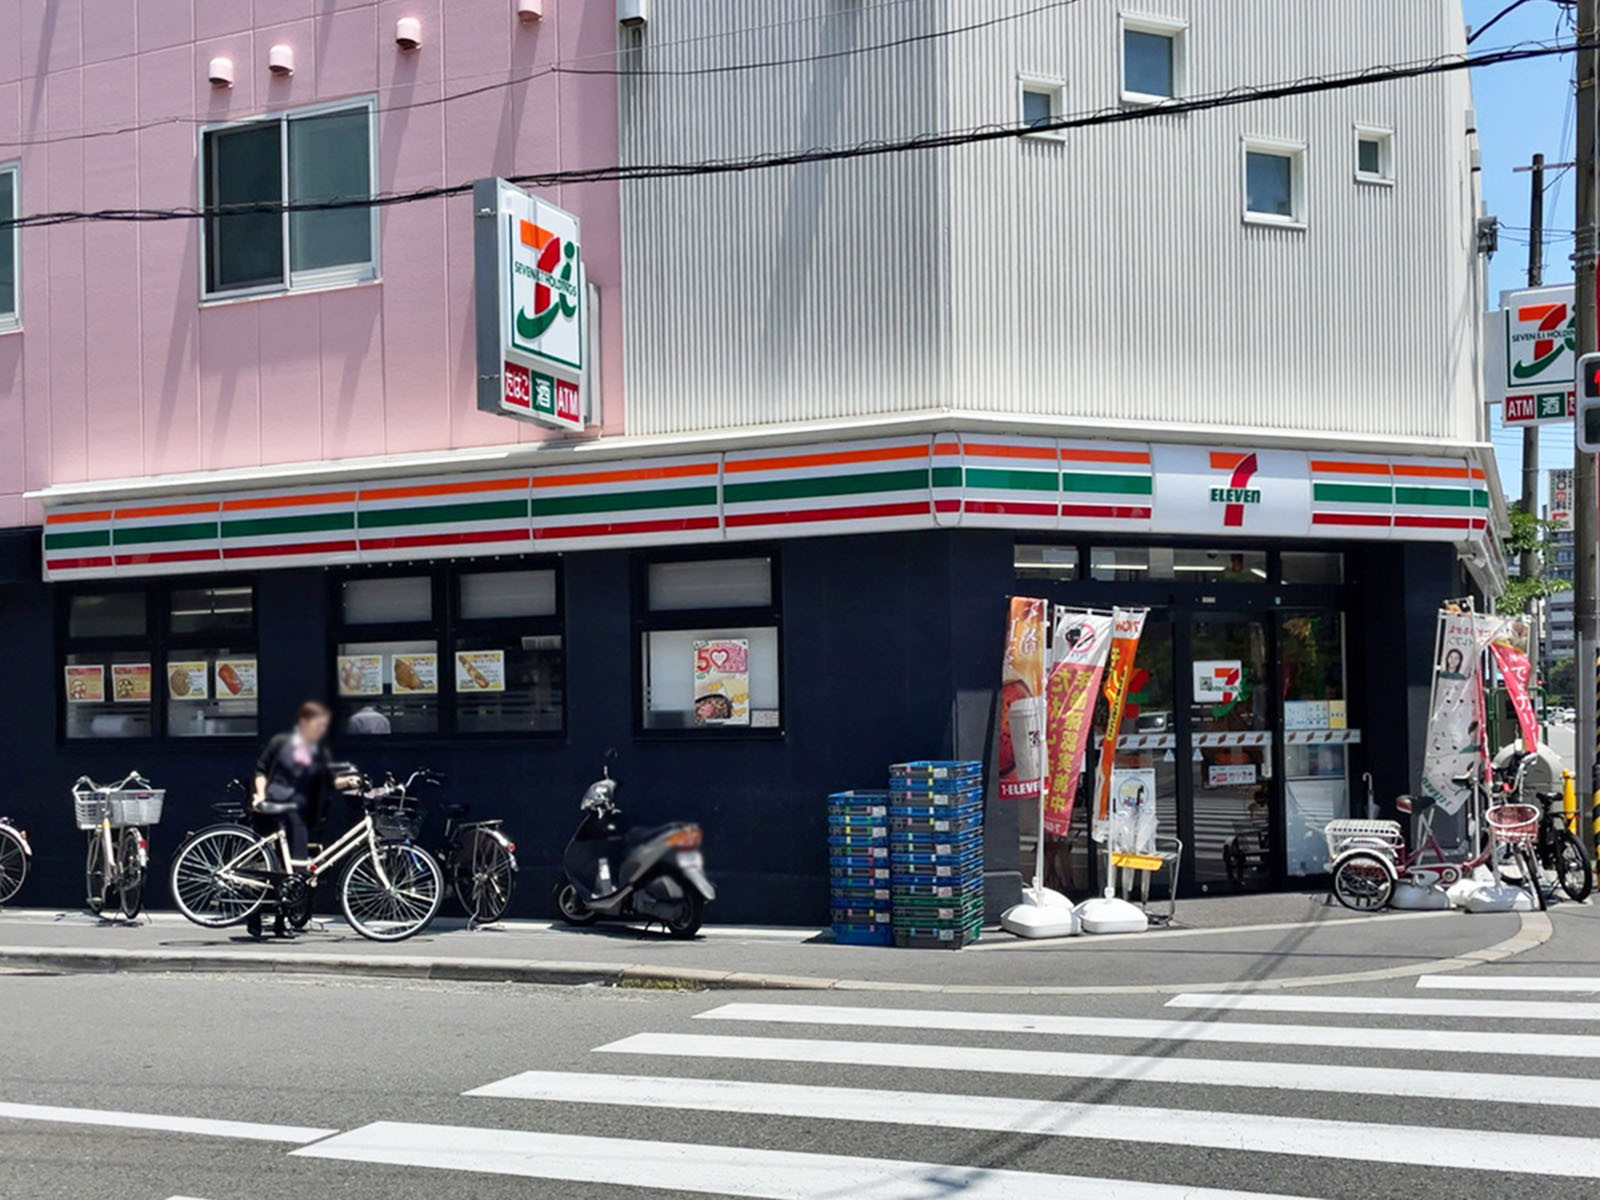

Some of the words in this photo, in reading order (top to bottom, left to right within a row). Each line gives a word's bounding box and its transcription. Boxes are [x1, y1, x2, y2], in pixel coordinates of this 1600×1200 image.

[505, 370, 529, 401] たばこ
[535, 378, 551, 408] 酒
[558, 386, 578, 415] ATM
[1508, 399, 1534, 418] ATM
[1542, 396, 1560, 415] 酒
